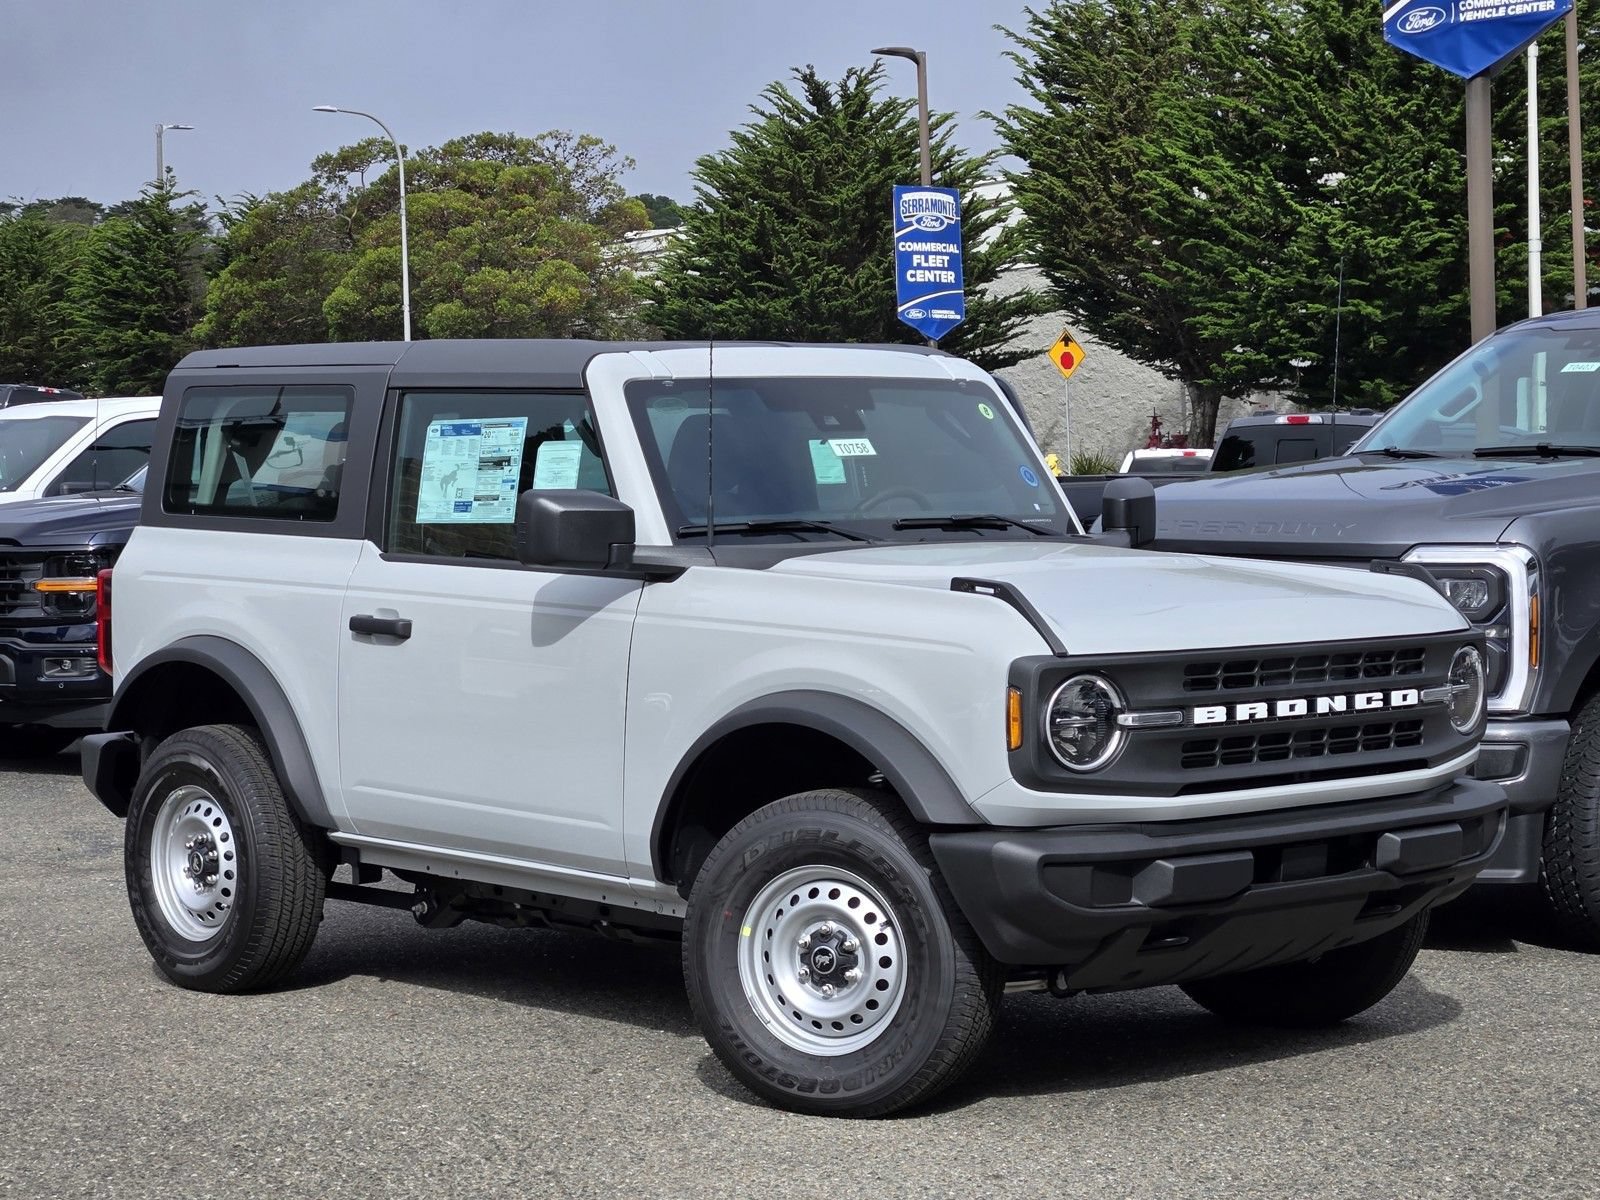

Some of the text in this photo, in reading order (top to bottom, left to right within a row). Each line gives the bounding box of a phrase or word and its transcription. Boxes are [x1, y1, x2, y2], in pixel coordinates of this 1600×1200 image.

[1459, 0, 1555, 21] VEHICLE CENTER
[901, 197, 955, 217] SERRAMONTE
[899, 242, 959, 253] COMMERCIAL
[912, 254, 950, 267] FLEET
[906, 270, 955, 283] CENTER
[835, 442, 870, 454] T0758
[1250, 520, 1357, 536] DUTY
[1193, 688, 1419, 725] BRONCO
